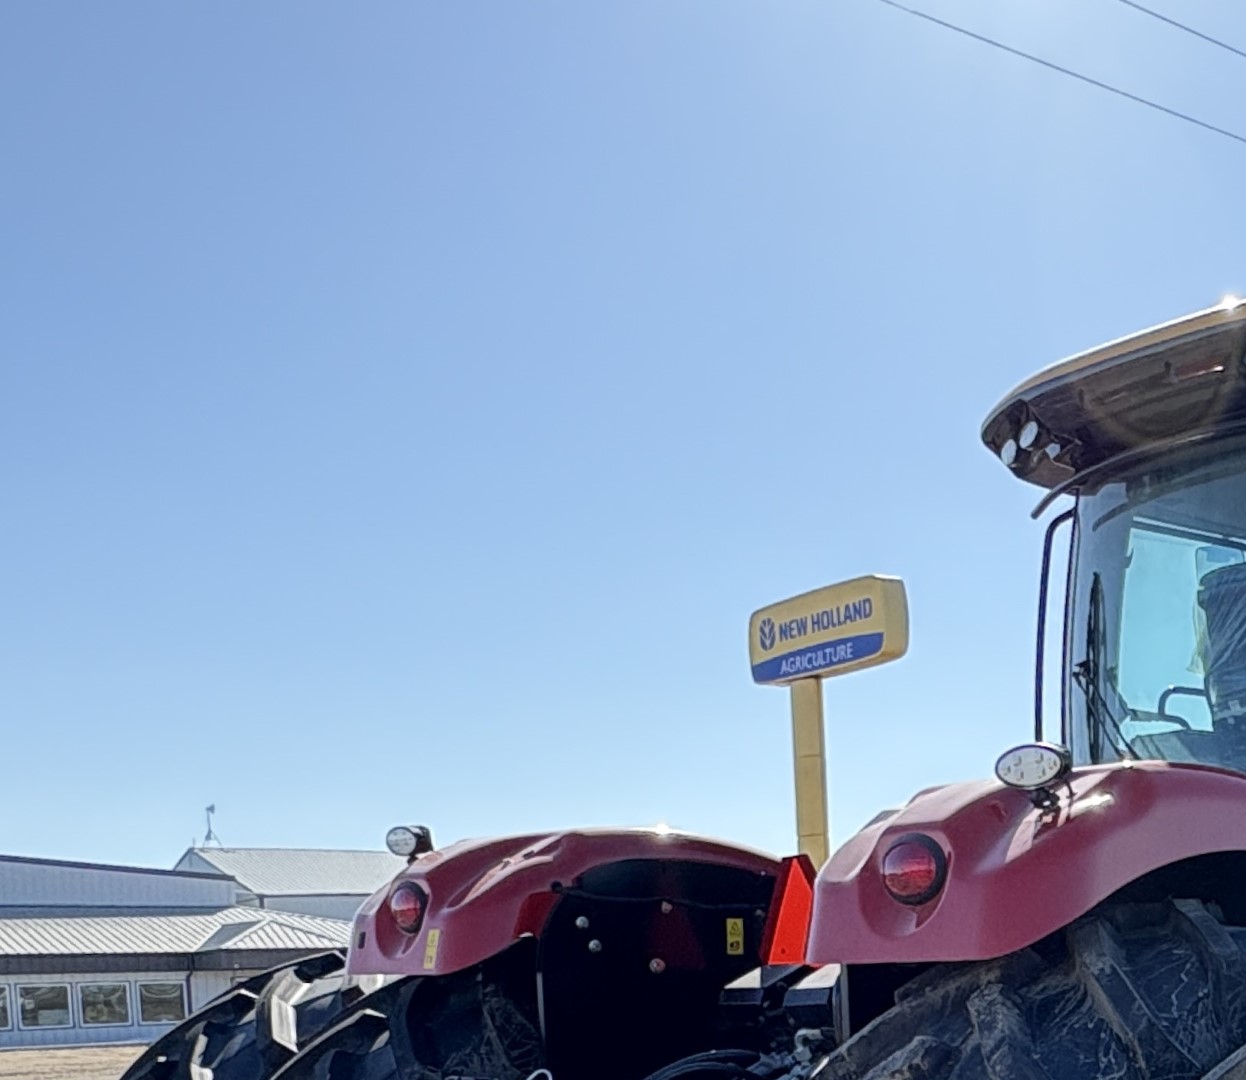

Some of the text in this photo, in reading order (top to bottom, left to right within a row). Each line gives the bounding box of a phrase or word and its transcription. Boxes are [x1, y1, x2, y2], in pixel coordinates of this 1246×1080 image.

[779, 598, 873, 641] NEW HOLLAND
[780, 643, 854, 674] AGRICULTURE
